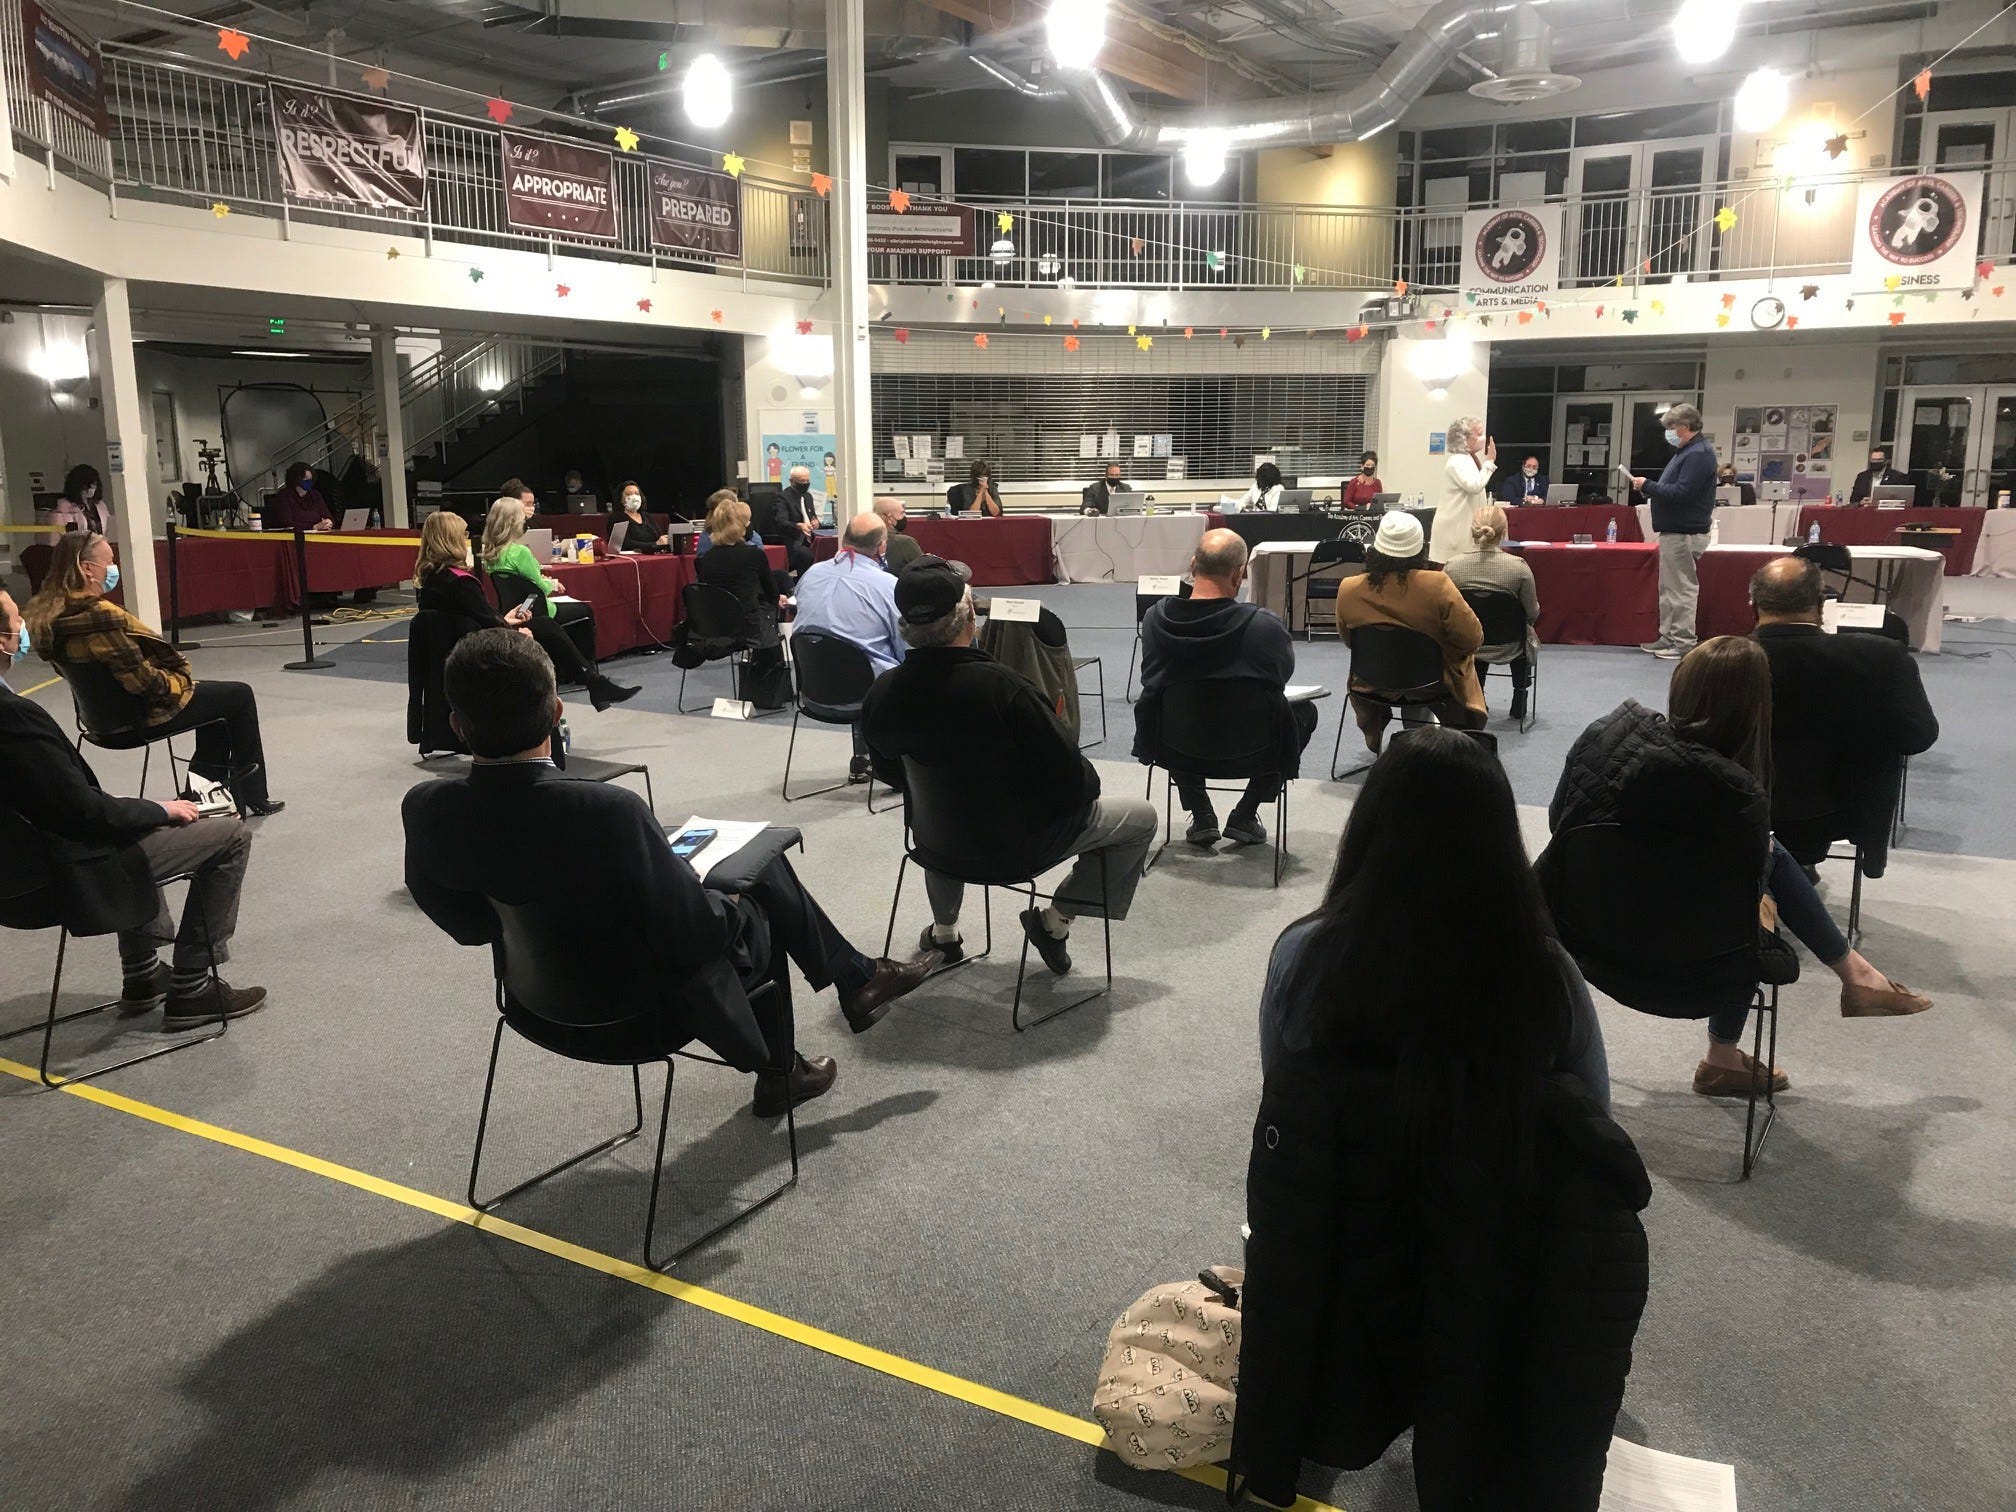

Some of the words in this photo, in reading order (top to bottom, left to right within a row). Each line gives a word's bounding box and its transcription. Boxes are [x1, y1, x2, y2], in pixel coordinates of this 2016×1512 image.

[280, 128, 415, 171] RESPECTFU
[510, 144, 522, 159] Is
[512, 173, 607, 205] APPROPRIATE
[661, 196, 732, 226] PREPARED
[1884, 275, 1940, 286] SINESS
[1476, 297, 1499, 307] ARTS
[1501, 296, 1508, 306] &
